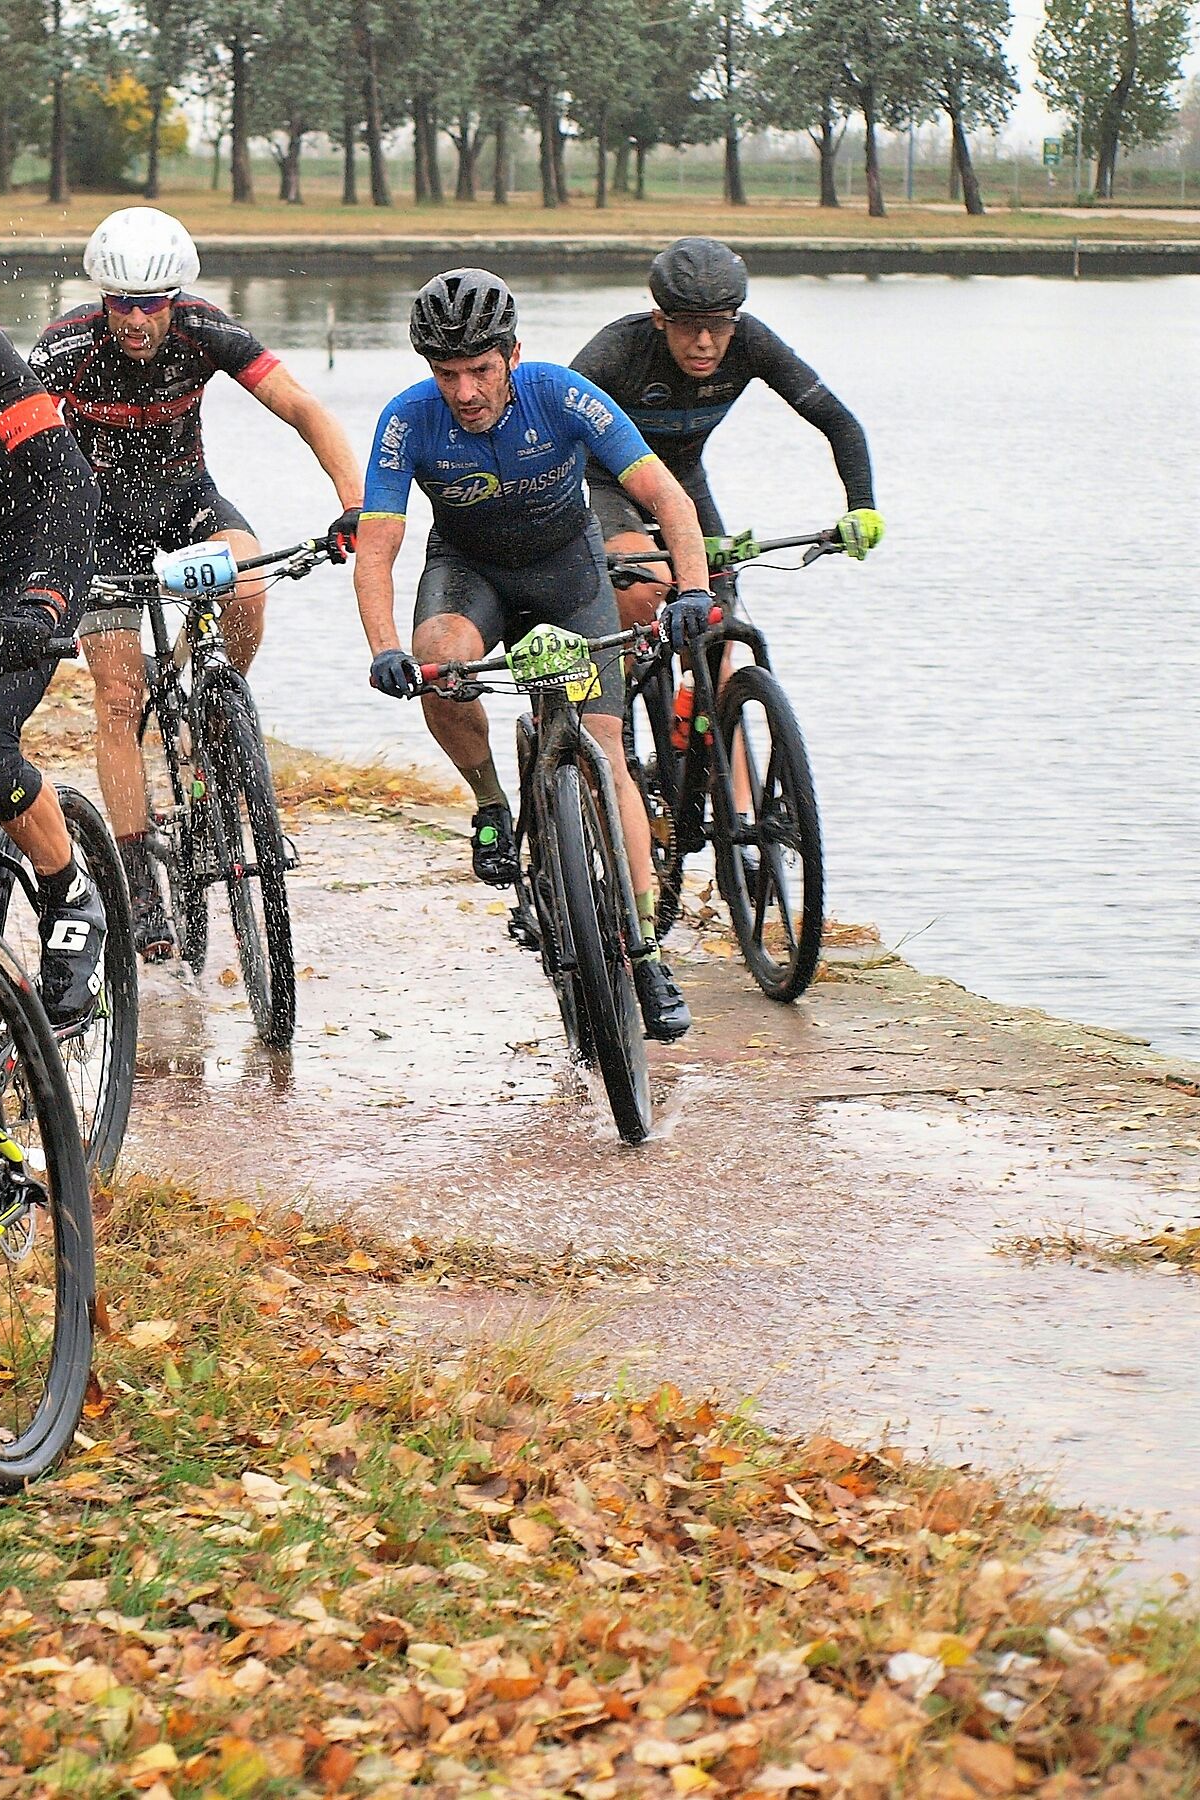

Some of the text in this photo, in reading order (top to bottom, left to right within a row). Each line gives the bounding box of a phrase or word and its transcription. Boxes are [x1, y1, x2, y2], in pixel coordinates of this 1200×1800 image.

[518, 452, 577, 496] PASSION
[184, 563, 216, 589] 80
[47, 919, 91, 951] G
